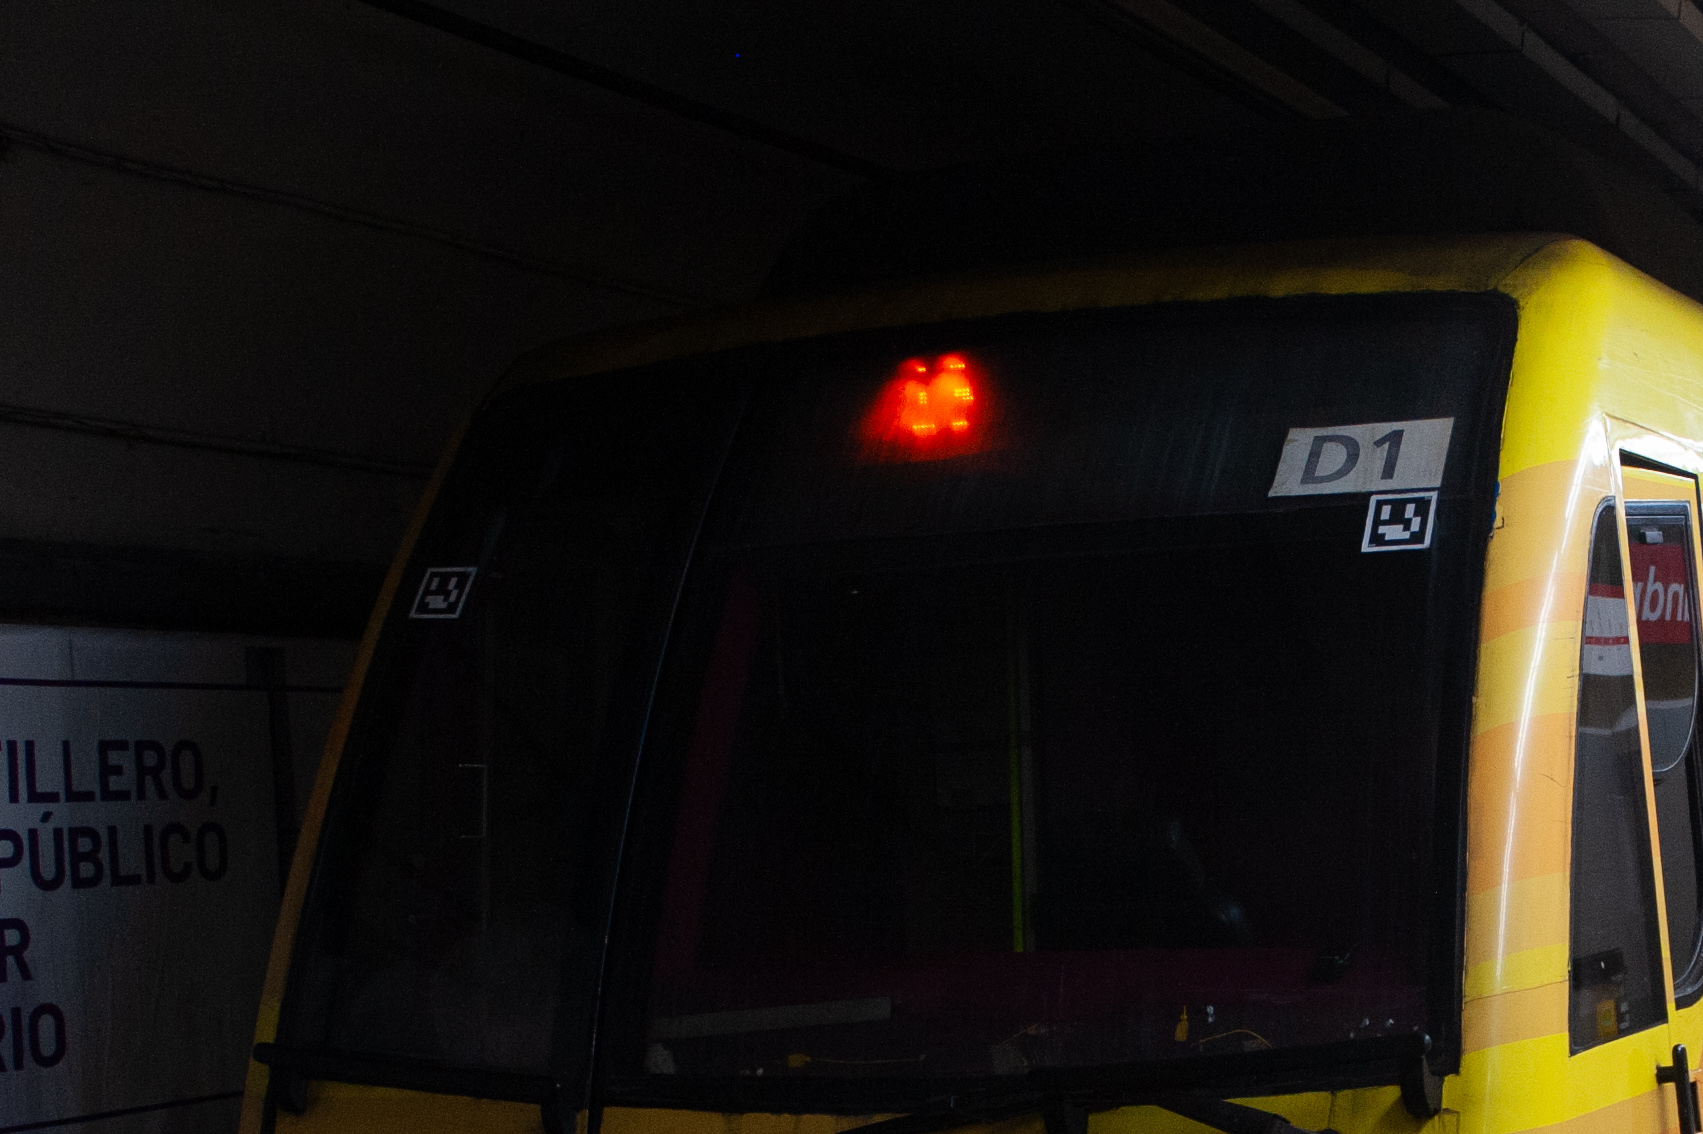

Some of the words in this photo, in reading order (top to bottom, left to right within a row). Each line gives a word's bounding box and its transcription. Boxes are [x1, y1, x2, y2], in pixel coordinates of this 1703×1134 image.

[1300, 429, 1405, 485] D1
[0, 739, 218, 807] ILLERO,
[0, 811, 228, 891] PÚBLICO
[0, 1002, 66, 1072] IO
